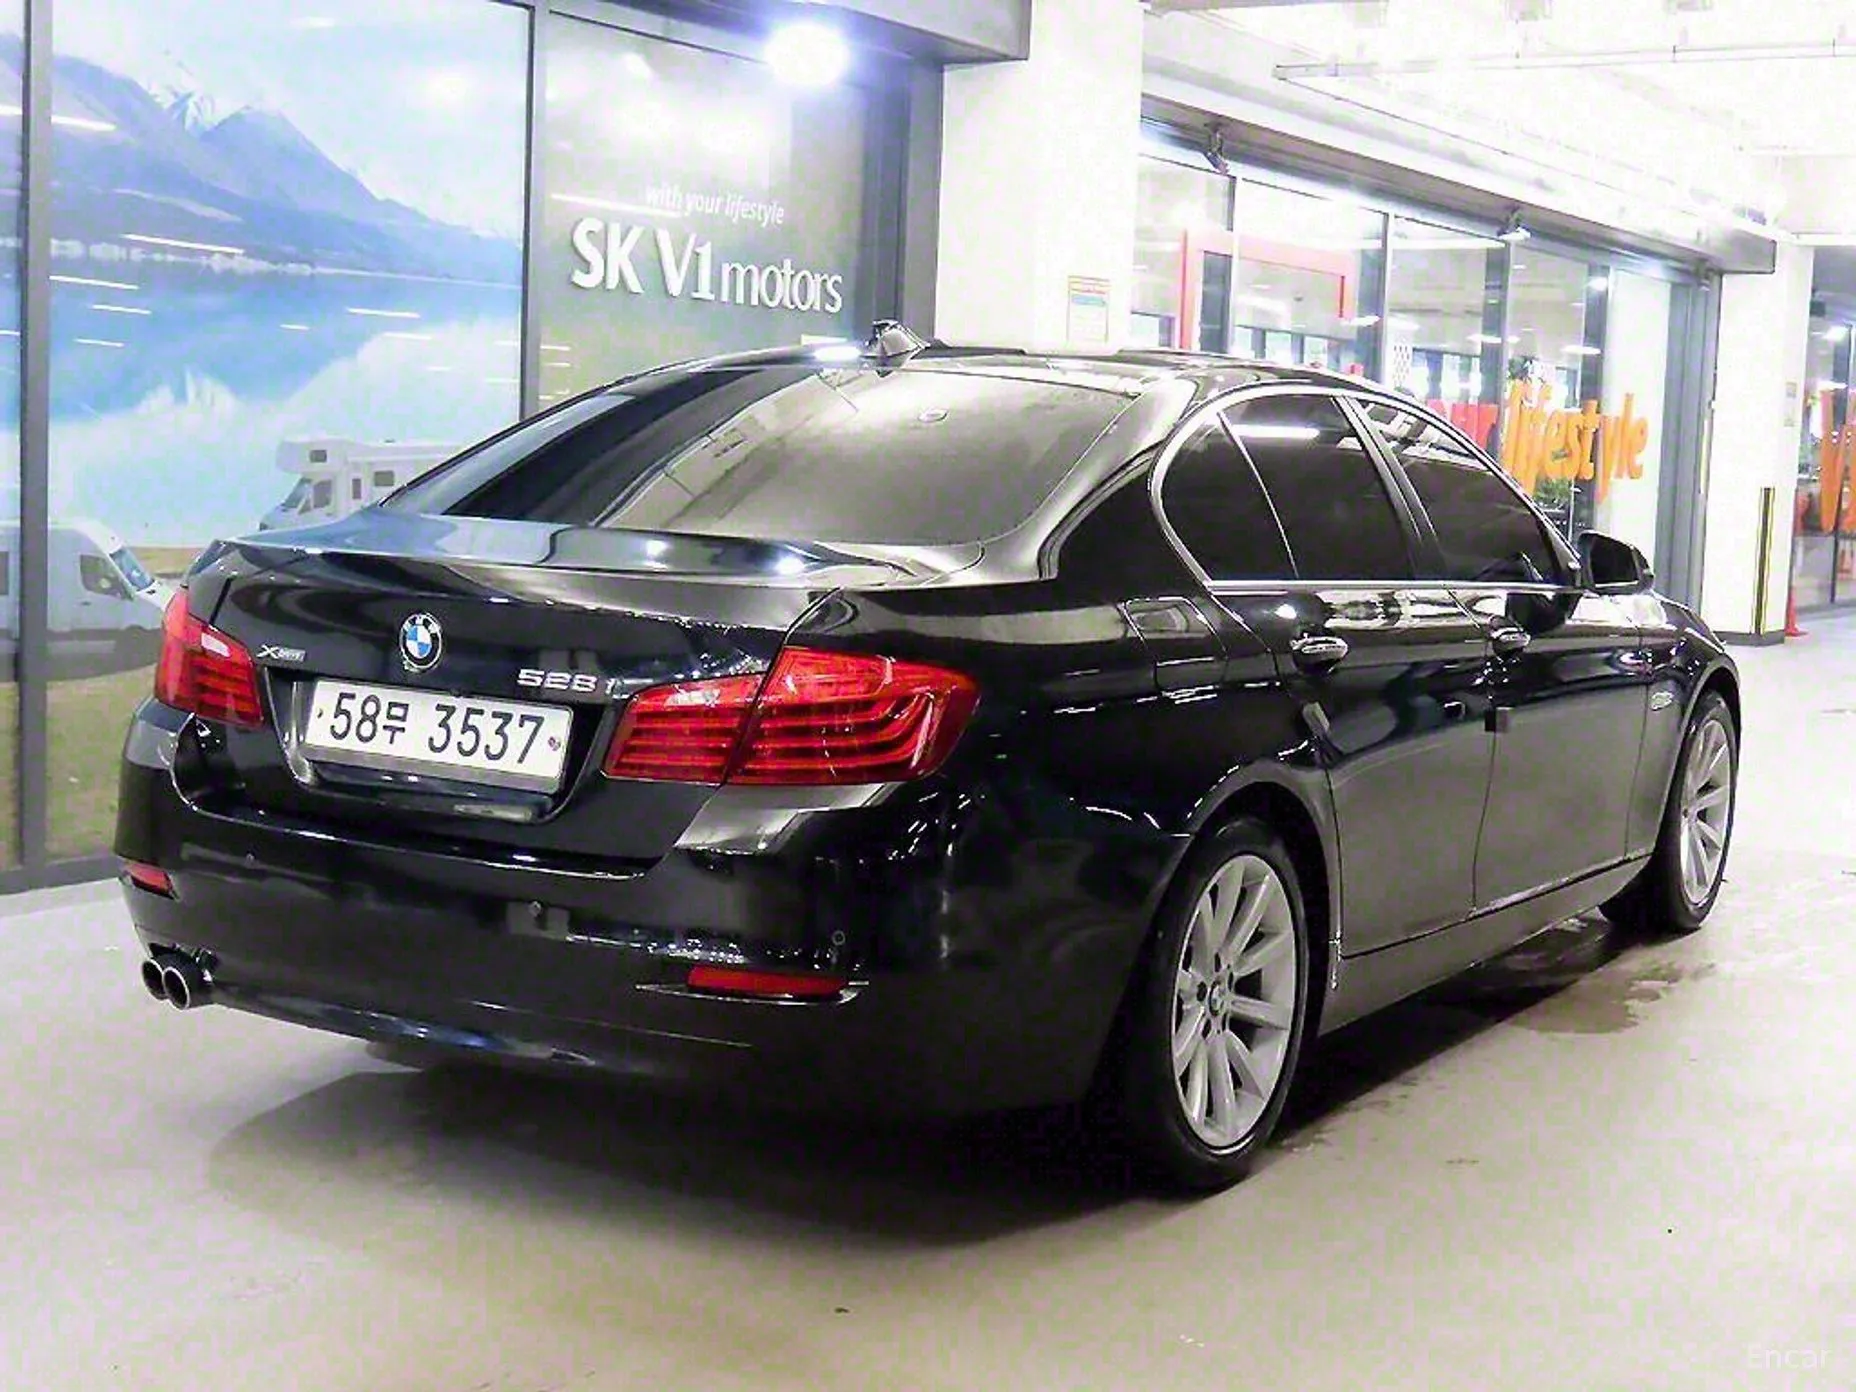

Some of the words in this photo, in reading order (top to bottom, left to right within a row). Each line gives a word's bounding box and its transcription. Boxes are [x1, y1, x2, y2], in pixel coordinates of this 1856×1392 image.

[647, 185, 682, 209] with
[684, 192, 722, 217] your
[724, 193, 785, 228] lifestyle
[570, 217, 645, 295] SK
[654, 227, 715, 301] V1
[720, 257, 843, 314] motors
[328, 691, 410, 745] 58무
[427, 702, 546, 764] 3537
